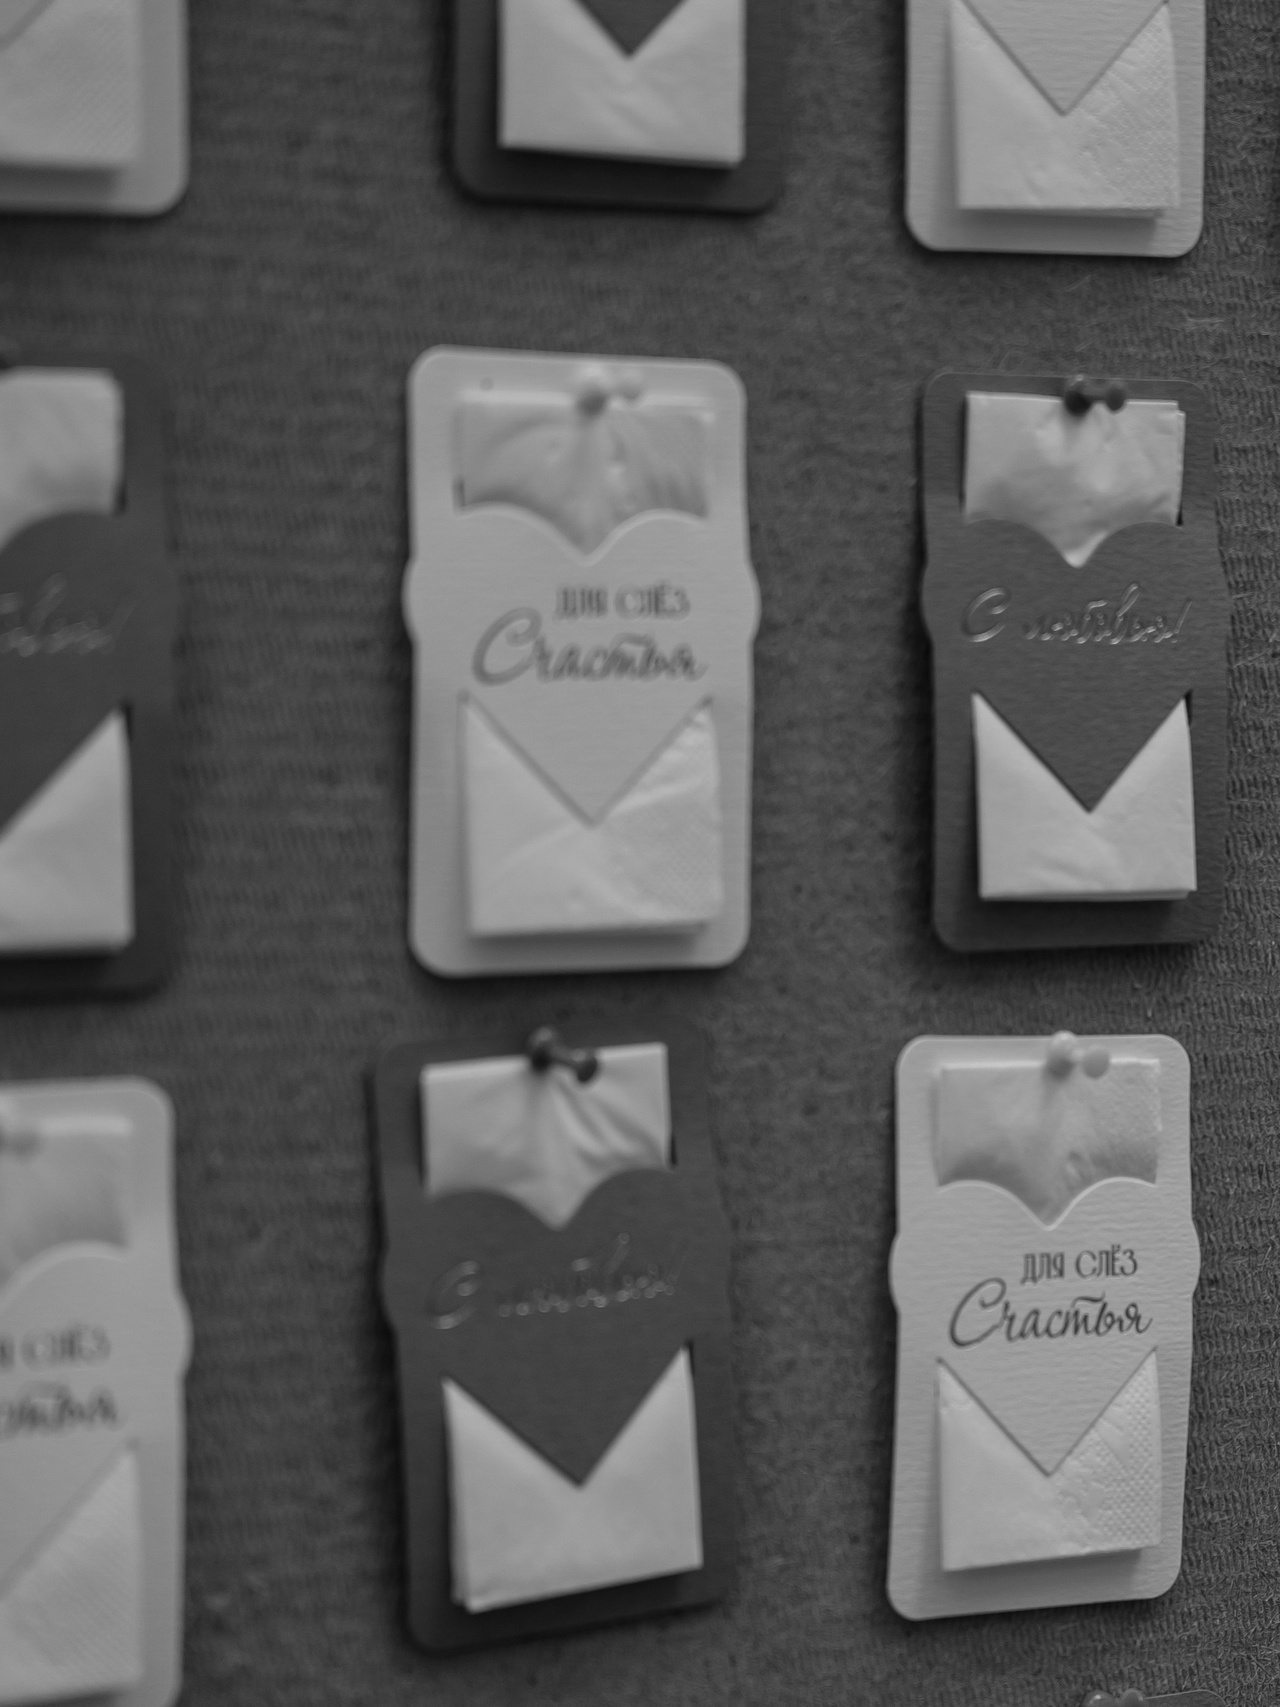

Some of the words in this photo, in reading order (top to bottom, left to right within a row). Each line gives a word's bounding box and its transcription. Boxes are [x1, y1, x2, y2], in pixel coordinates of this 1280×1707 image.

[471, 606, 709, 688] Счастья
[1020, 1251, 1066, 1286] ДЛЯ
[1074, 1244, 1139, 1279] СЛЁЗ
[948, 1276, 1153, 1349] Счастья
